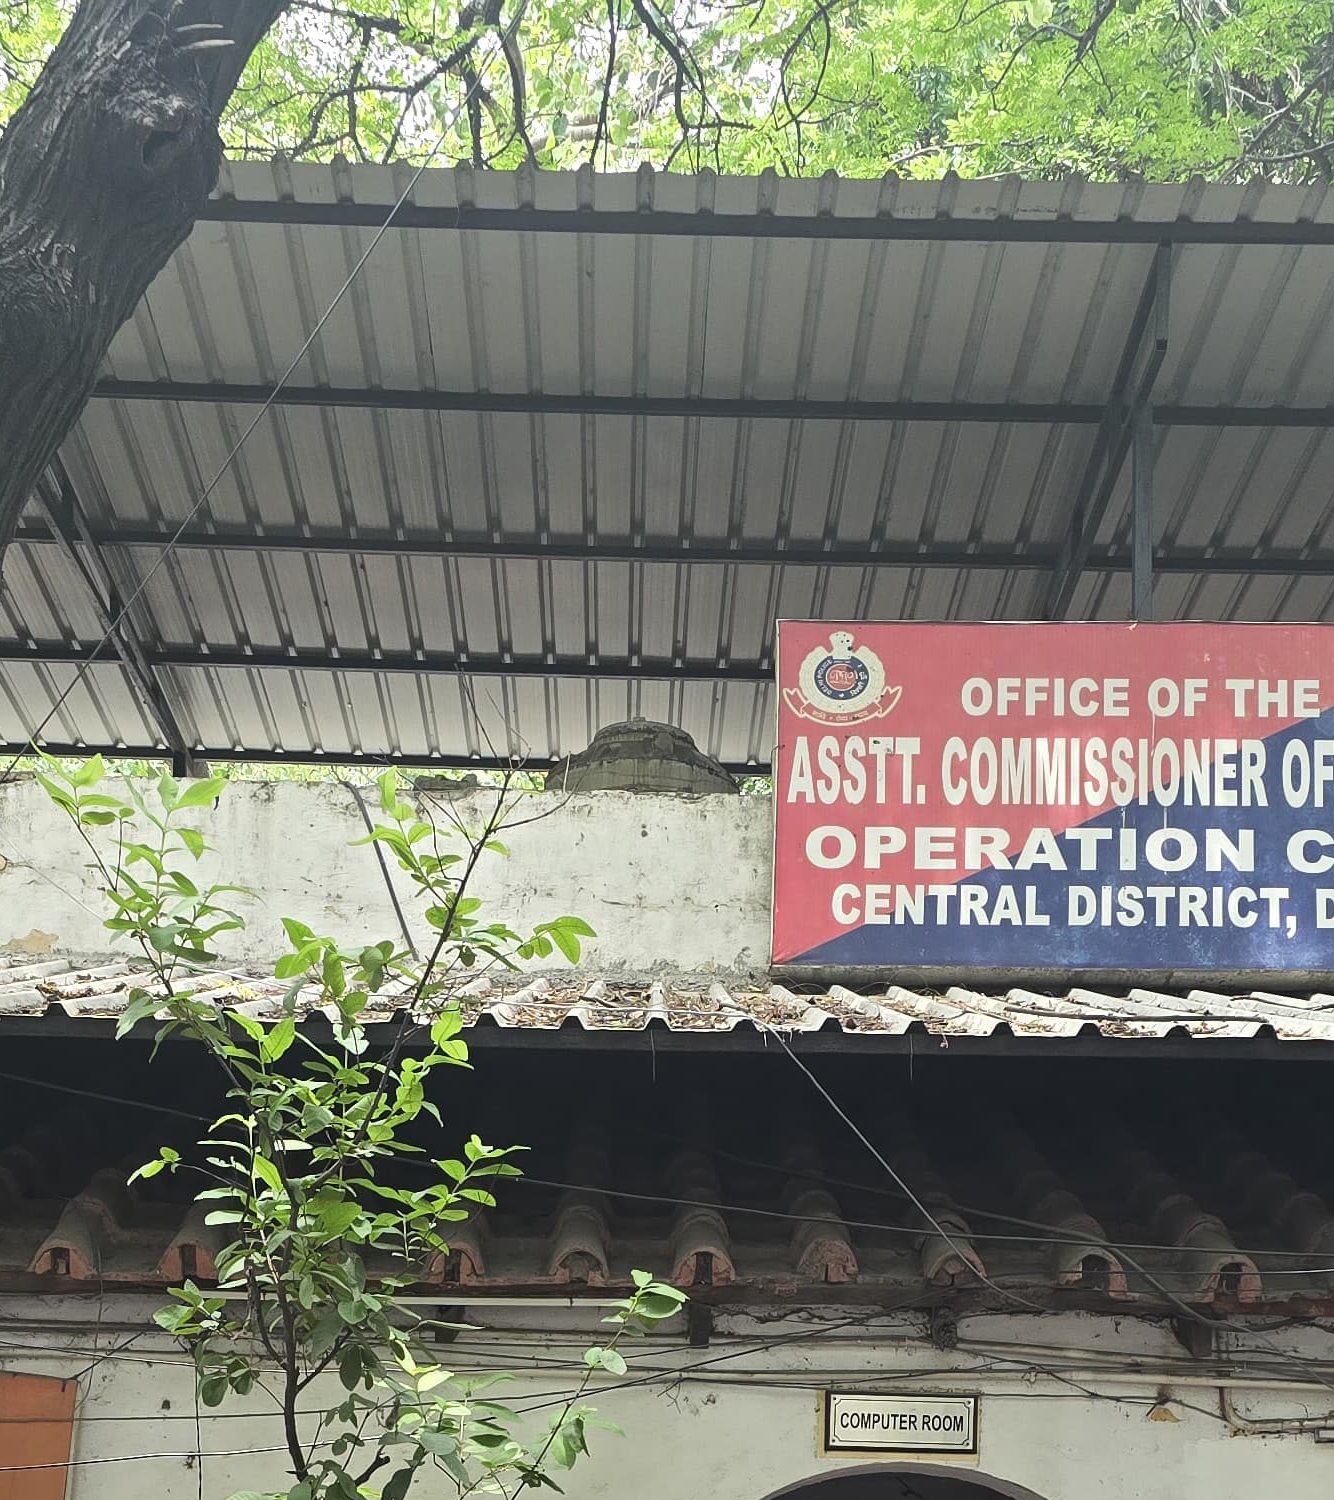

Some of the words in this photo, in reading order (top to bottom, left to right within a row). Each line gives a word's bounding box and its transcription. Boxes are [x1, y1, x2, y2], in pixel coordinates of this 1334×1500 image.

[961, 677, 1131, 718] OFFICE
[1147, 678, 1208, 718] OF
[1224, 678, 1321, 719] THE
[786, 736, 926, 806] ASSTT.
[940, 736, 1269, 807] COMMISSIONER
[1281, 738, 1334, 809] OF
[805, 825, 1255, 873] OPERATION
[831, 882, 1051, 928] CENTRAL
[1066, 885, 1298, 939] DISTRICT,
[840, 1412, 918, 1431] COMPUTER
[921, 1415, 964, 1433] ROOM
